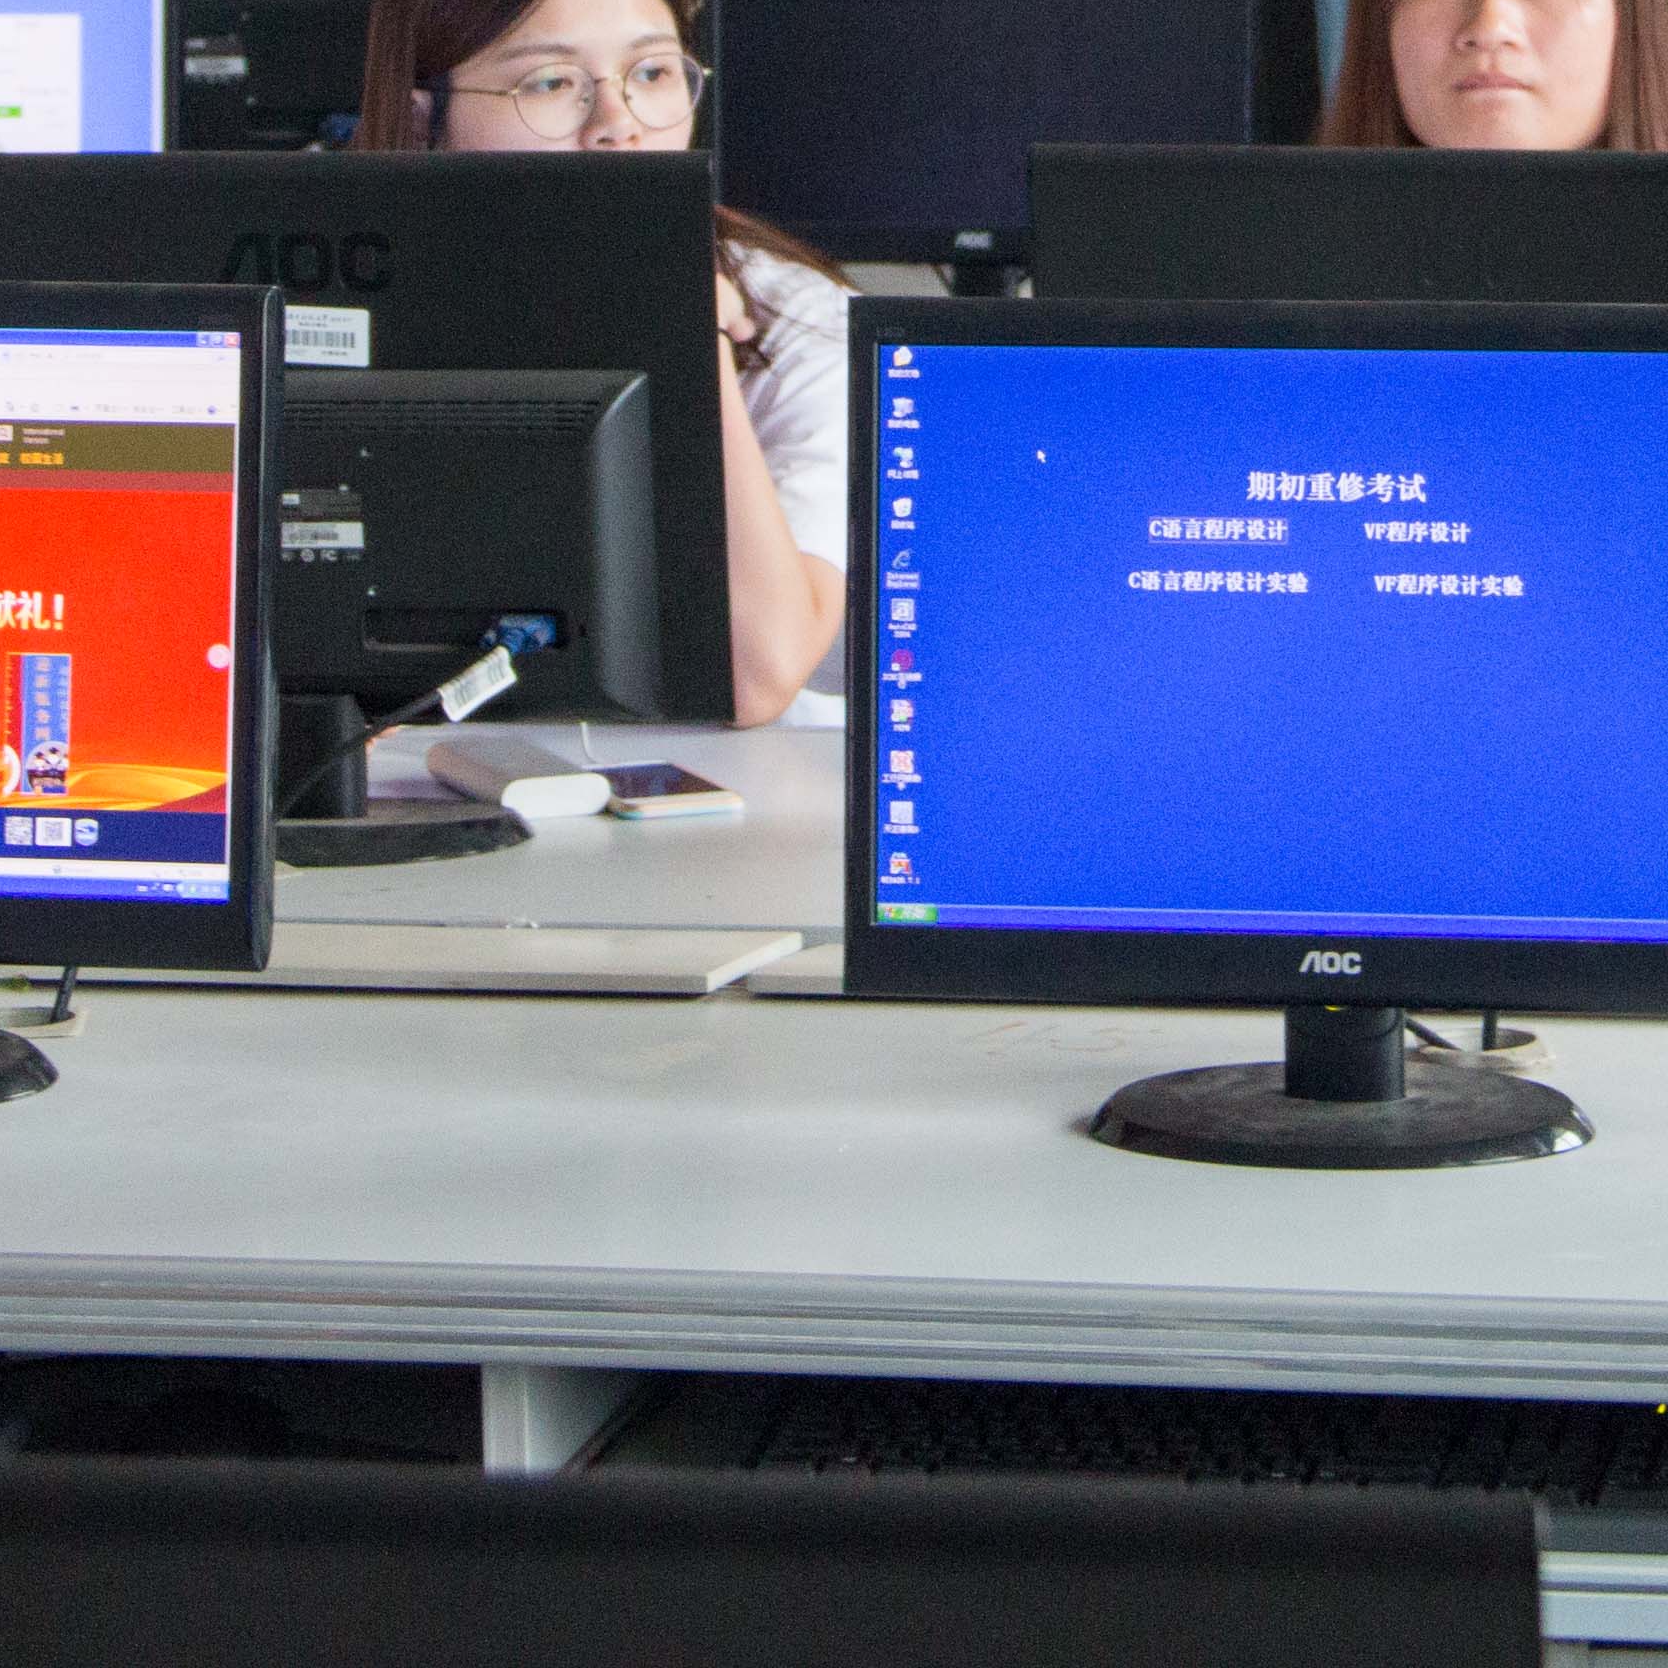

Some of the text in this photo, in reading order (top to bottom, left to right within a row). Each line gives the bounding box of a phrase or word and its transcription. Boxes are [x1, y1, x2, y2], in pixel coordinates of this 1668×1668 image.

[219, 231, 392, 292] AOC
[1246, 471, 1427, 503] 期初重修考试
[1148, 518, 1471, 544] C语言程序设计 VF程序设计
[1128, 570, 1525, 597] C语言程序设计实验 VF程序设计实验
[1299, 950, 1363, 975] AOC
